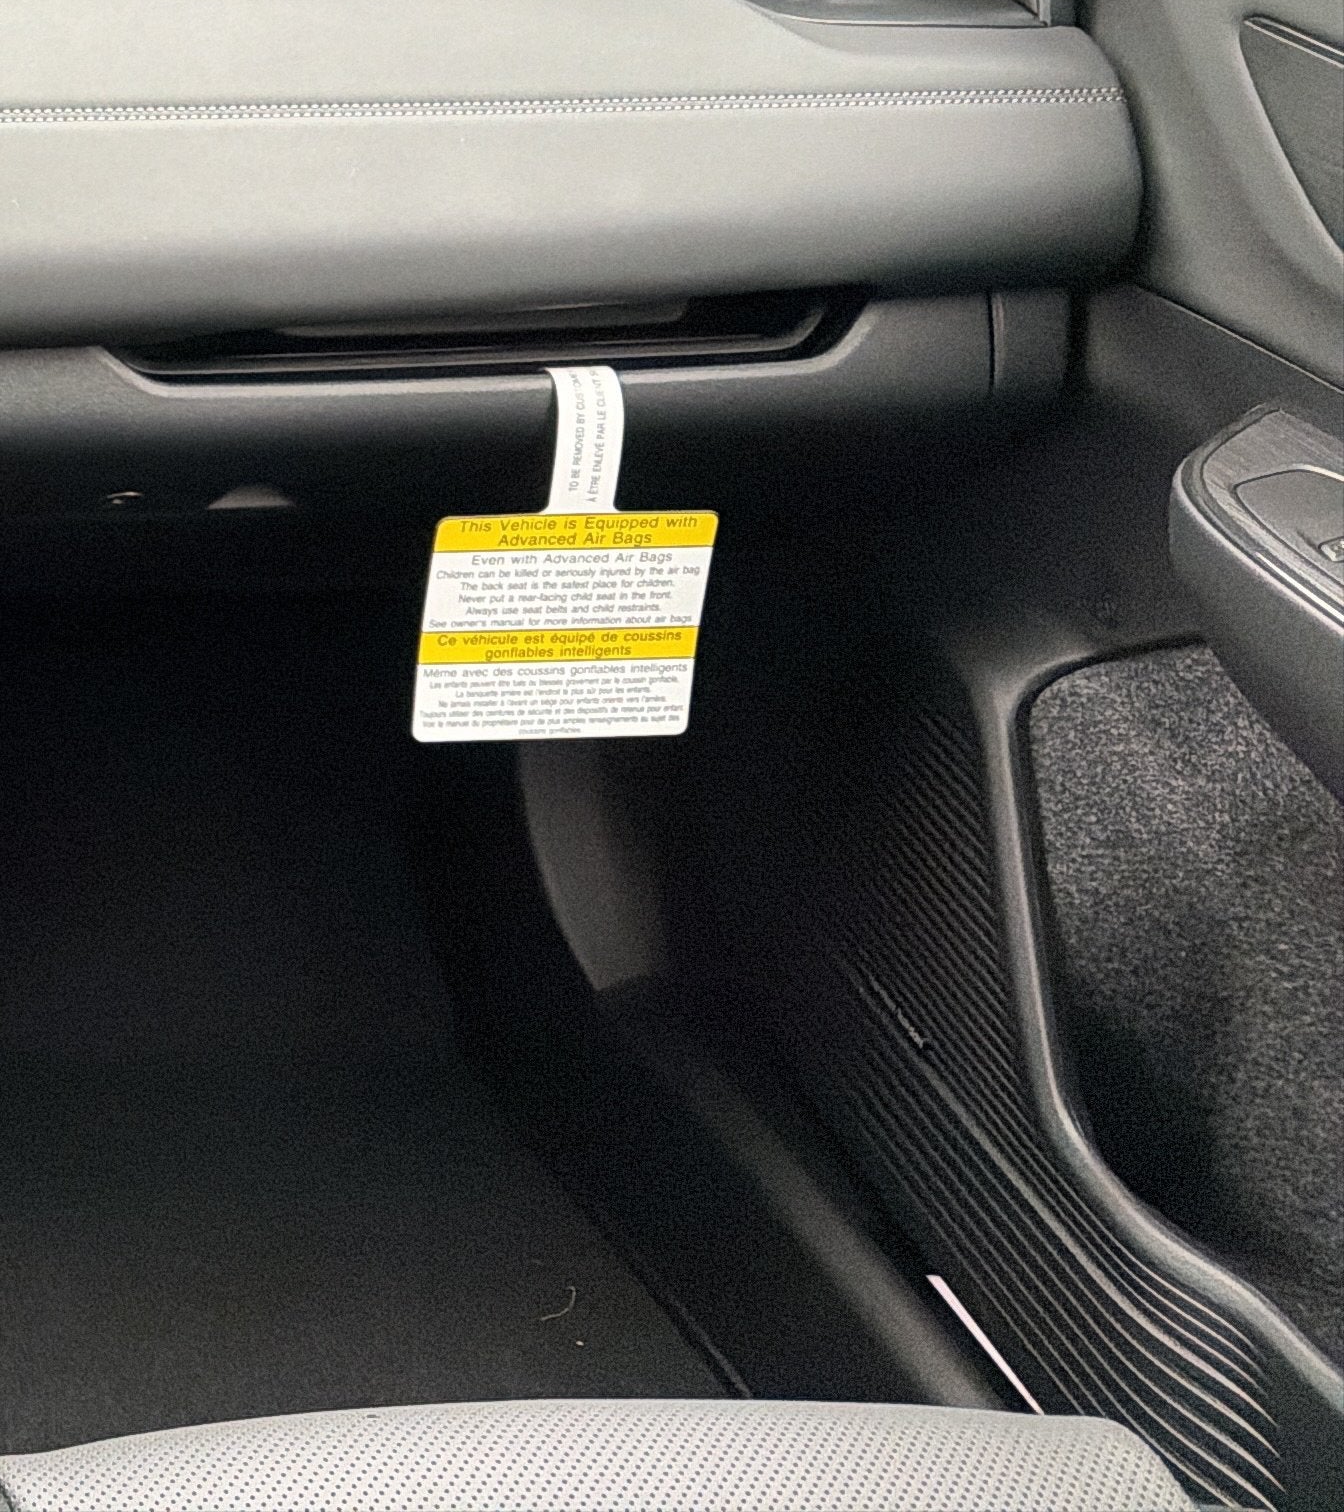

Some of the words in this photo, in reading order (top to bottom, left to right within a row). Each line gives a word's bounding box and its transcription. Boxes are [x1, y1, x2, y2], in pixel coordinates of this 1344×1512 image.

[576, 413, 586, 424] BY
[597, 410, 606, 420] LE
[596, 423, 606, 439] PAR
[572, 426, 585, 466] REMOVED
[571, 468, 581, 479] BE
[460, 520, 492, 532] This
[499, 519, 557, 531] Vehicle
[564, 518, 577, 530] is
[584, 516, 659, 531] Equipped
[666, 515, 698, 528] with
[497, 533, 577, 547] Advanced
[583, 532, 606, 545] Air
[612, 531, 653, 547] Bags
[471, 554, 505, 565] Even
[511, 554, 537, 565] with
[543, 552, 610, 564] Advanced
[614, 552, 634, 563] Air
[639, 551, 673, 564] Bags
[436, 570, 474, 579] Children
[478, 570, 495, 578] can
[498, 569, 511, 578] be
[514, 569, 539, 577] killed
[542, 569, 552, 577] or
[555, 568, 596, 579] seriously
[599, 568, 631, 579] injured
[634, 567, 645, 577] by
[649, 566, 664, 575] the
[667, 566, 680, 575] air
[460, 582, 478, 591] The
[481, 581, 503, 591] back
[507, 581, 527, 590] seat
[531, 581, 539, 590] is
[543, 580, 557, 589] the
[592, 579, 617, 590] place
[621, 579, 634, 588] for
[458, 594, 485, 603] Never
[489, 594, 505, 604] put
[570, 592, 593, 601] child
[596, 592, 616, 600] seat
[619, 591, 628, 600] in
[631, 591, 646, 599] the
[465, 606, 498, 617] Always
[502, 607, 519, 615] use
[522, 606, 542, 614] seat
[545, 605, 567, 614] belts
[571, 605, 589, 613] and
[592, 604, 615, 613] child
[429, 619, 447, 628] See
[490, 618, 524, 626] manual
[528, 617, 540, 626] for
[625, 615, 652, 624] about
[654, 615, 666, 623] air
[437, 634, 457, 646] Ce
[463, 634, 518, 645] véhicule
[524, 633, 544, 644] est
[550, 632, 595, 645] équipé
[601, 632, 618, 643] de
[623, 630, 682, 642] coussins
[485, 647, 554, 662] gonflables
[559, 645, 632, 659] intelligents
[462, 669, 488, 677] avec
[493, 667, 513, 676] des
[517, 667, 565, 676] coussins
[631, 663, 688, 674] intelligents
